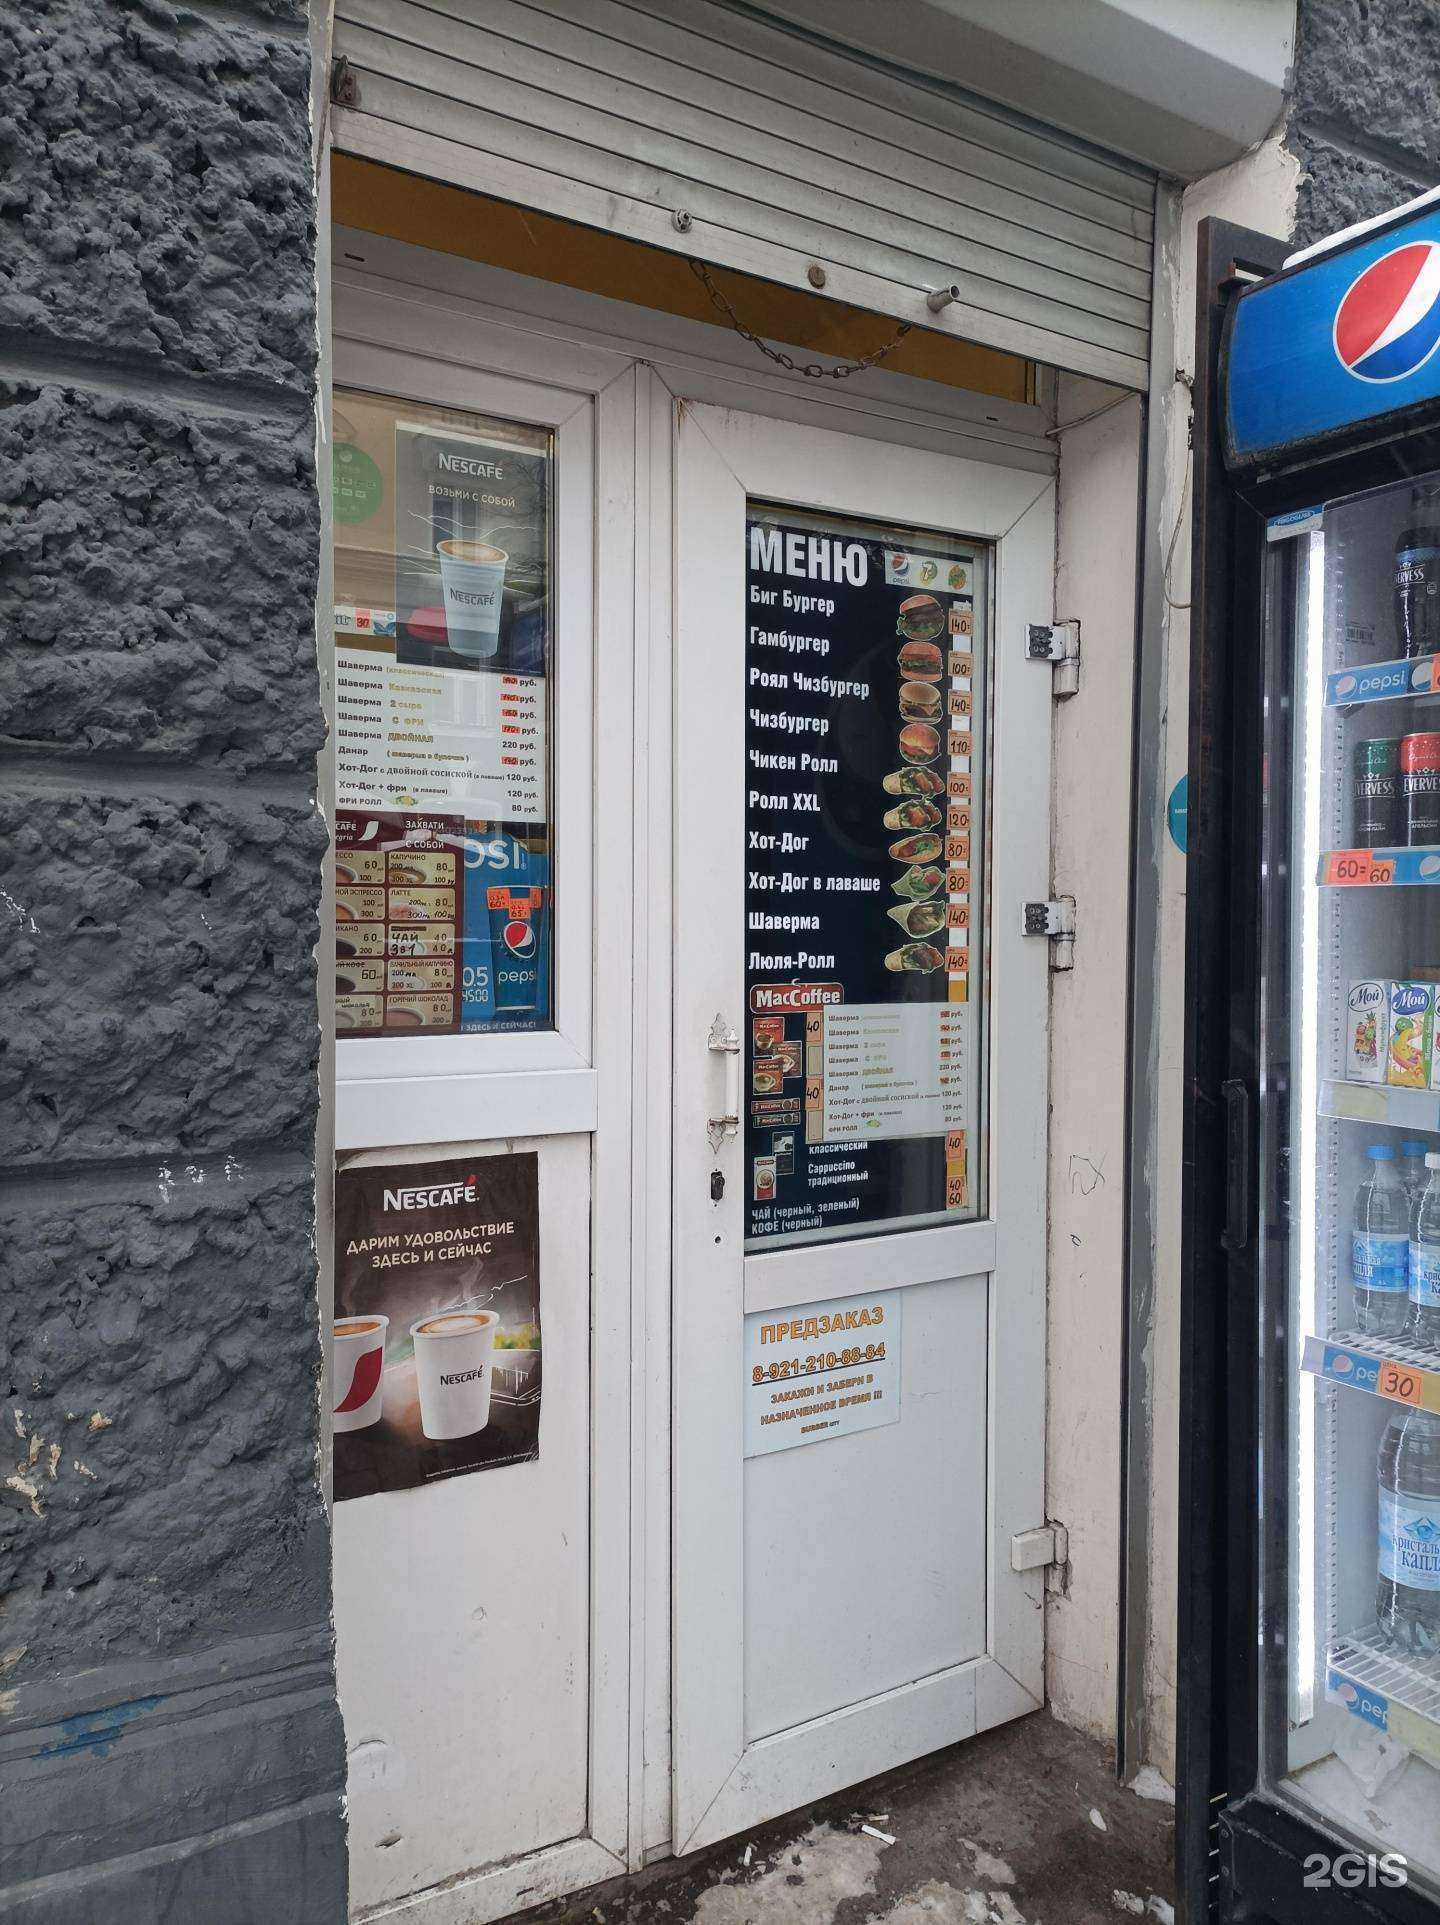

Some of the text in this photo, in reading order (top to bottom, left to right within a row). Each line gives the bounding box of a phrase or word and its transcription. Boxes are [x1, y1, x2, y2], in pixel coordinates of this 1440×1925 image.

[750, 526, 868, 587] МЕНЮ
[750, 584, 835, 617] Биг Бургер
[750, 626, 830, 656] Гамбургер
[338, 660, 382, 673] Шаверма
[338, 678, 383, 690] Шаверма
[750, 667, 870, 700] Роял Чизбургер
[1359, 670, 1405, 692] pepsi
[338, 696, 382, 707] Шаверма
[338, 713, 382, 724] Шаверма
[750, 708, 829, 736] Чизбургер
[338, 729, 382, 740] Шаверма
[502, 741, 518, 749] 220
[750, 749, 838, 773] Чикен Ролл
[338, 763, 378, 773] Хот-Дог
[506, 774, 521, 782] 120
[338, 780, 376, 791] Хот-Дог
[750, 790, 821, 811] Ролл XXL
[406, 820, 444, 830] ЗАХВАТИ
[749, 831, 809, 853] Хот-Дог
[749, 871, 881, 893] Хот-Дог в лаваше
[1370, 868, 1391, 883] 60
[749, 912, 820, 933] Шаверма
[363, 934, 377, 942] 60
[392, 932, 418, 943] ЧАЙ
[749, 952, 835, 970] Люля-Ролл
[756, 988, 841, 1008] MacCoffee
[1393, 990, 1426, 1009] Мой
[806, 1021, 819, 1032] 40
[806, 1088, 819, 1100] 40
[949, 1138, 960, 1149] 40
[808, 1161, 856, 1175] Cappuccino
[808, 1171, 869, 1188] традиционный
[949, 1179, 960, 1191] 40
[752, 1197, 860, 1220] ЧАЙ (черный, зеленый)
[752, 1215, 822, 1235] КОФЕ (черный)
[346, 1221, 515, 1255] ДАРИМ УДОВОЛЬСТВИЕ
[371, 1241, 492, 1268] ЗДЕСЬ И СЕЙЧАС
[761, 1307, 884, 1344] ПРЕДЗАКАЗ
[770, 1374, 874, 1404] ЗАКАЖИ И ЗАБЕРИ В
[1385, 1373, 1414, 1398] 30
[761, 1400, 837, 1425] НАЗНАЧЕННОЕ
[839, 1393, 872, 1408] ВРЕМЯ
